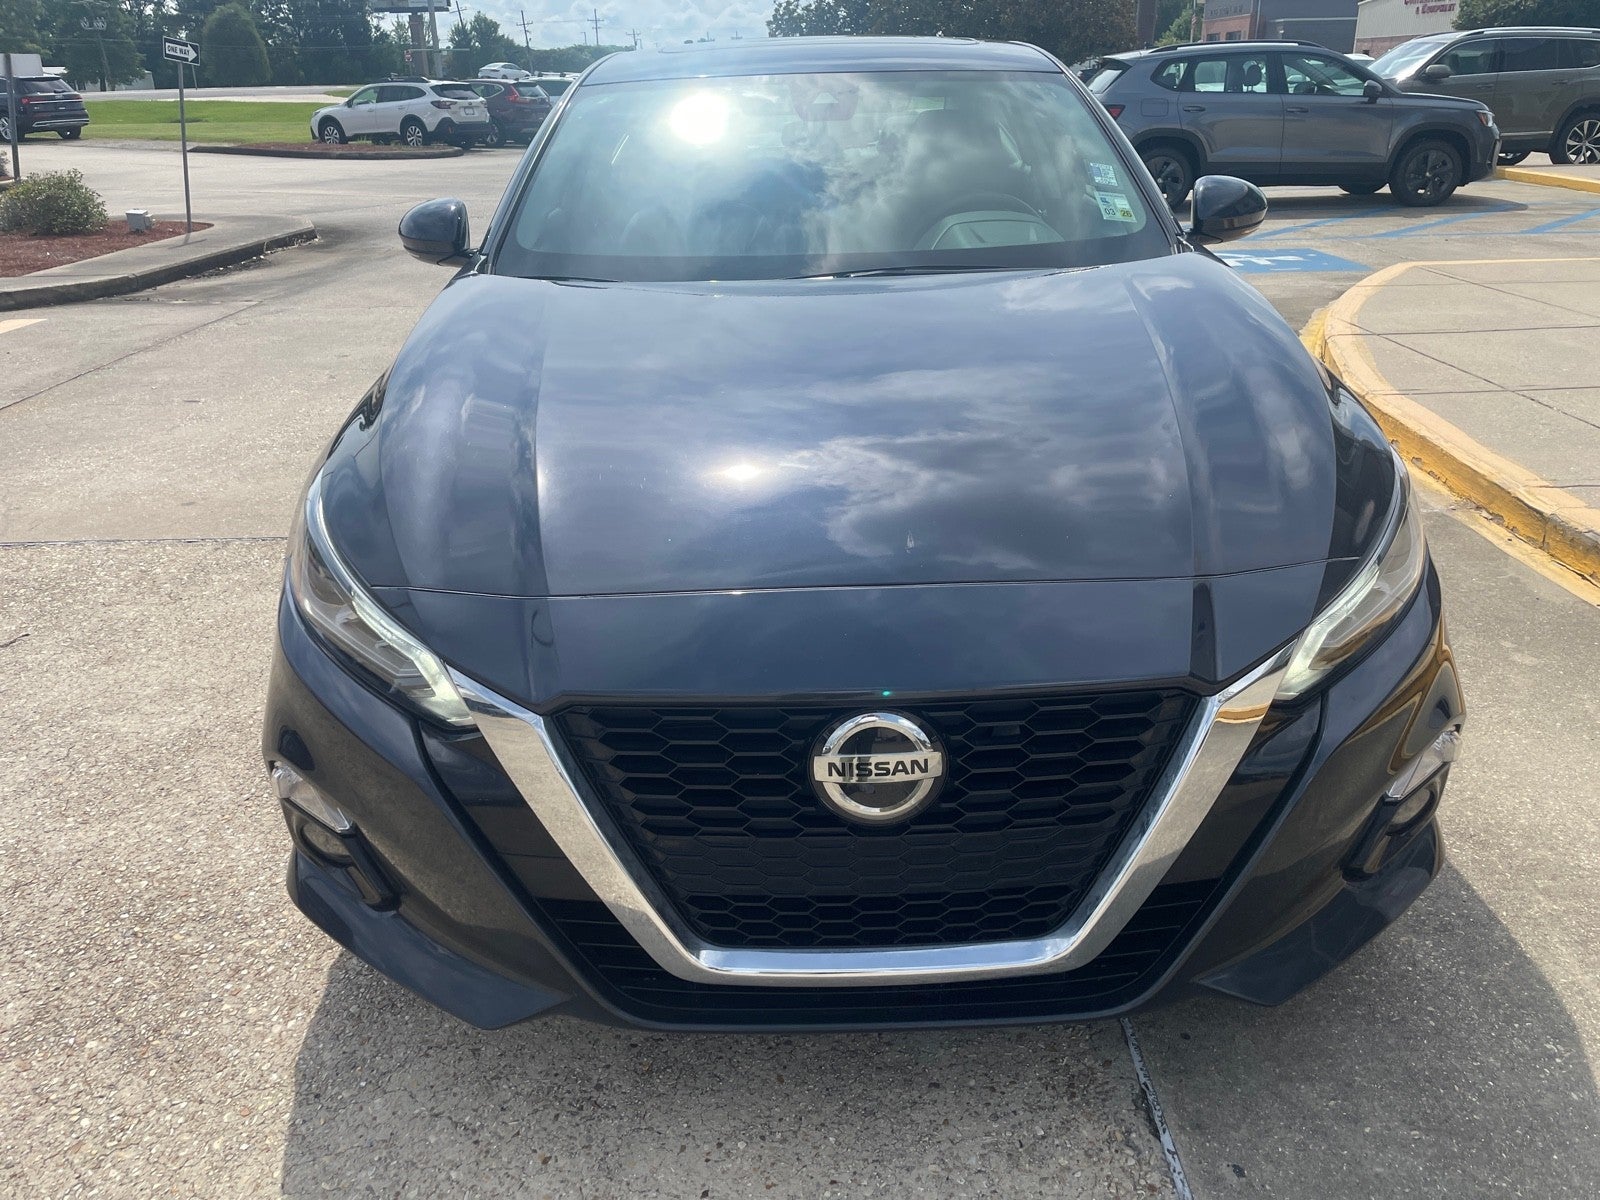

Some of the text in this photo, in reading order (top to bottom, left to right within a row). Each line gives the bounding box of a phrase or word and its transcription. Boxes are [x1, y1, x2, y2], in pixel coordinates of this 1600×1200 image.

[167, 44, 190, 56] ONE WAY
[1104, 207, 1116, 216] 03
[827, 758, 929, 778] NISSAN
